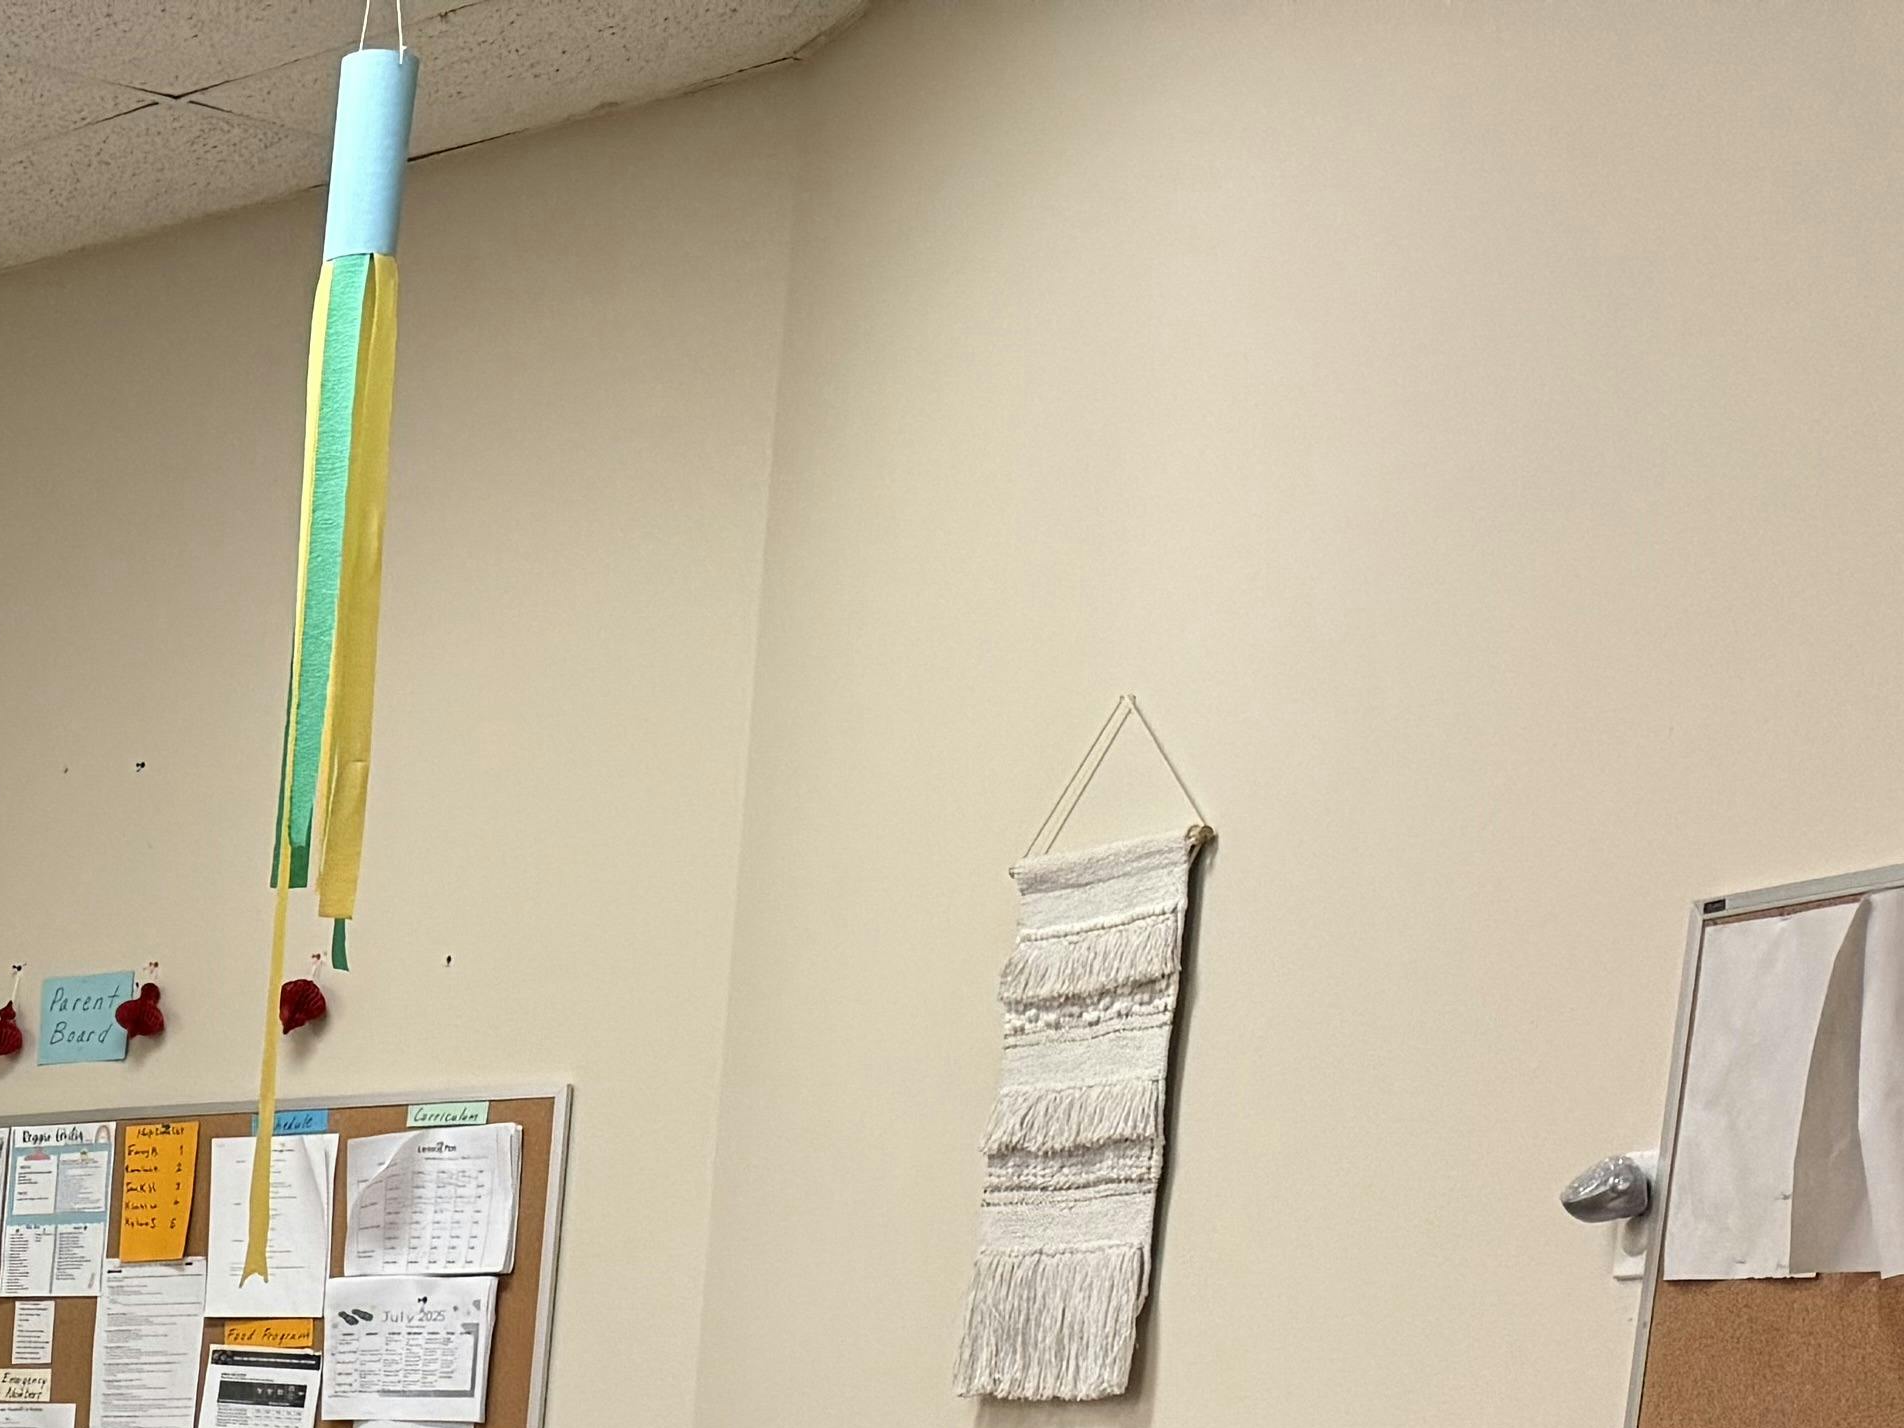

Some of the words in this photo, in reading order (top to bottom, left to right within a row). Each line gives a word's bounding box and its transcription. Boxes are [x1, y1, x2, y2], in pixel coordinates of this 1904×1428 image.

[49, 985, 120, 1012] Parent
[49, 1021, 113, 1045] Board
[383, 1310, 414, 1323] July
[418, 1310, 446, 1321] 2025
